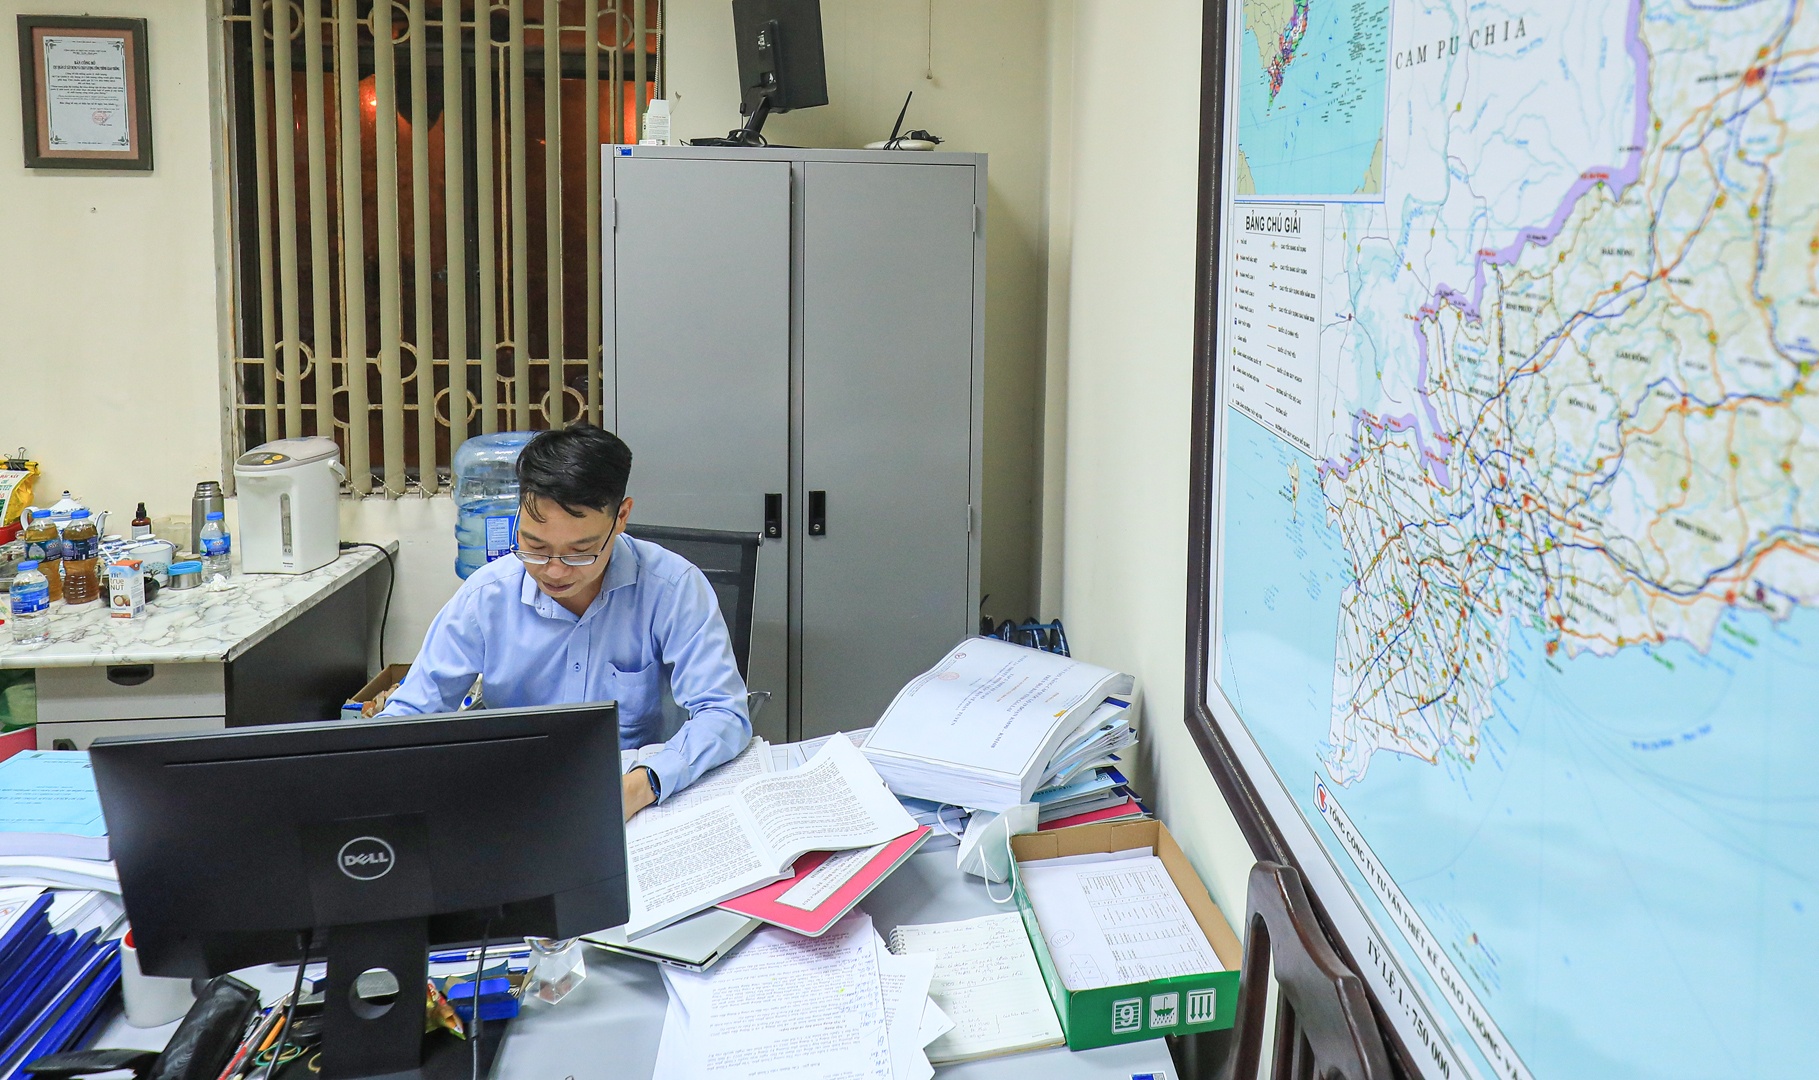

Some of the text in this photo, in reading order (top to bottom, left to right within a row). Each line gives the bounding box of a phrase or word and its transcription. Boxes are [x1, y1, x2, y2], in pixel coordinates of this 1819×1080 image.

[1395, 17, 1527, 70] CAM PU CHIA
[1246, 210, 1301, 234] BẢNG CHÚ GIẢI
[344, 852, 389, 866] DELL
[1328, 804, 1346, 834] TỔNG
[1346, 830, 1365, 862] CÔNG
[1366, 859, 1376, 877] TY
[1440, 966, 1464, 1006] GIAO
[1466, 1005, 1502, 1060] THÔNG
[1367, 936, 1380, 966] TỶ
[1382, 960, 1396, 995] LỆ
[1411, 1008, 1430, 1047] 750
[1430, 1042, 1450, 1080] 000
